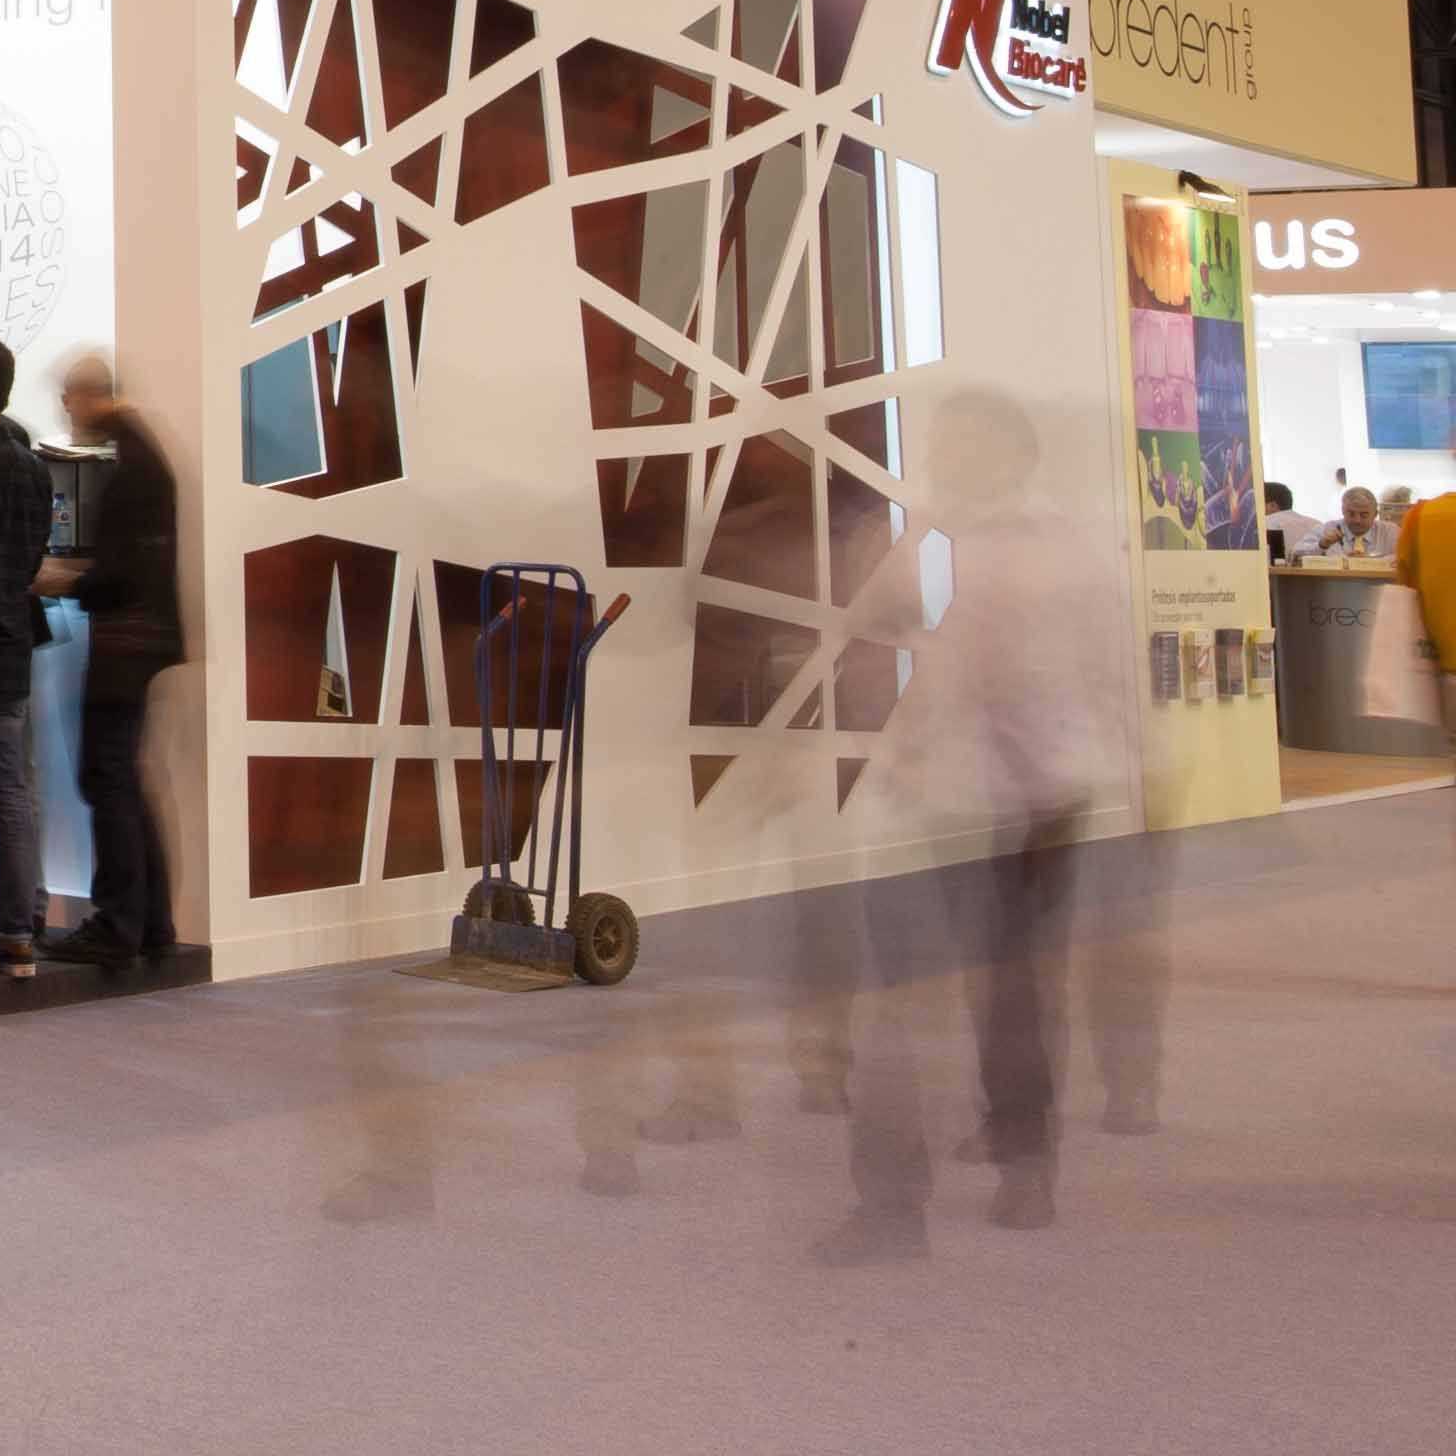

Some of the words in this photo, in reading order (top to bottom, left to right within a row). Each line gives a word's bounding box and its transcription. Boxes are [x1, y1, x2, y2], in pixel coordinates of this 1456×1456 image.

[1007, 37, 1087, 93] Biocare
[1242, 7, 1258, 101] group
[1253, 219, 1360, 270] us
